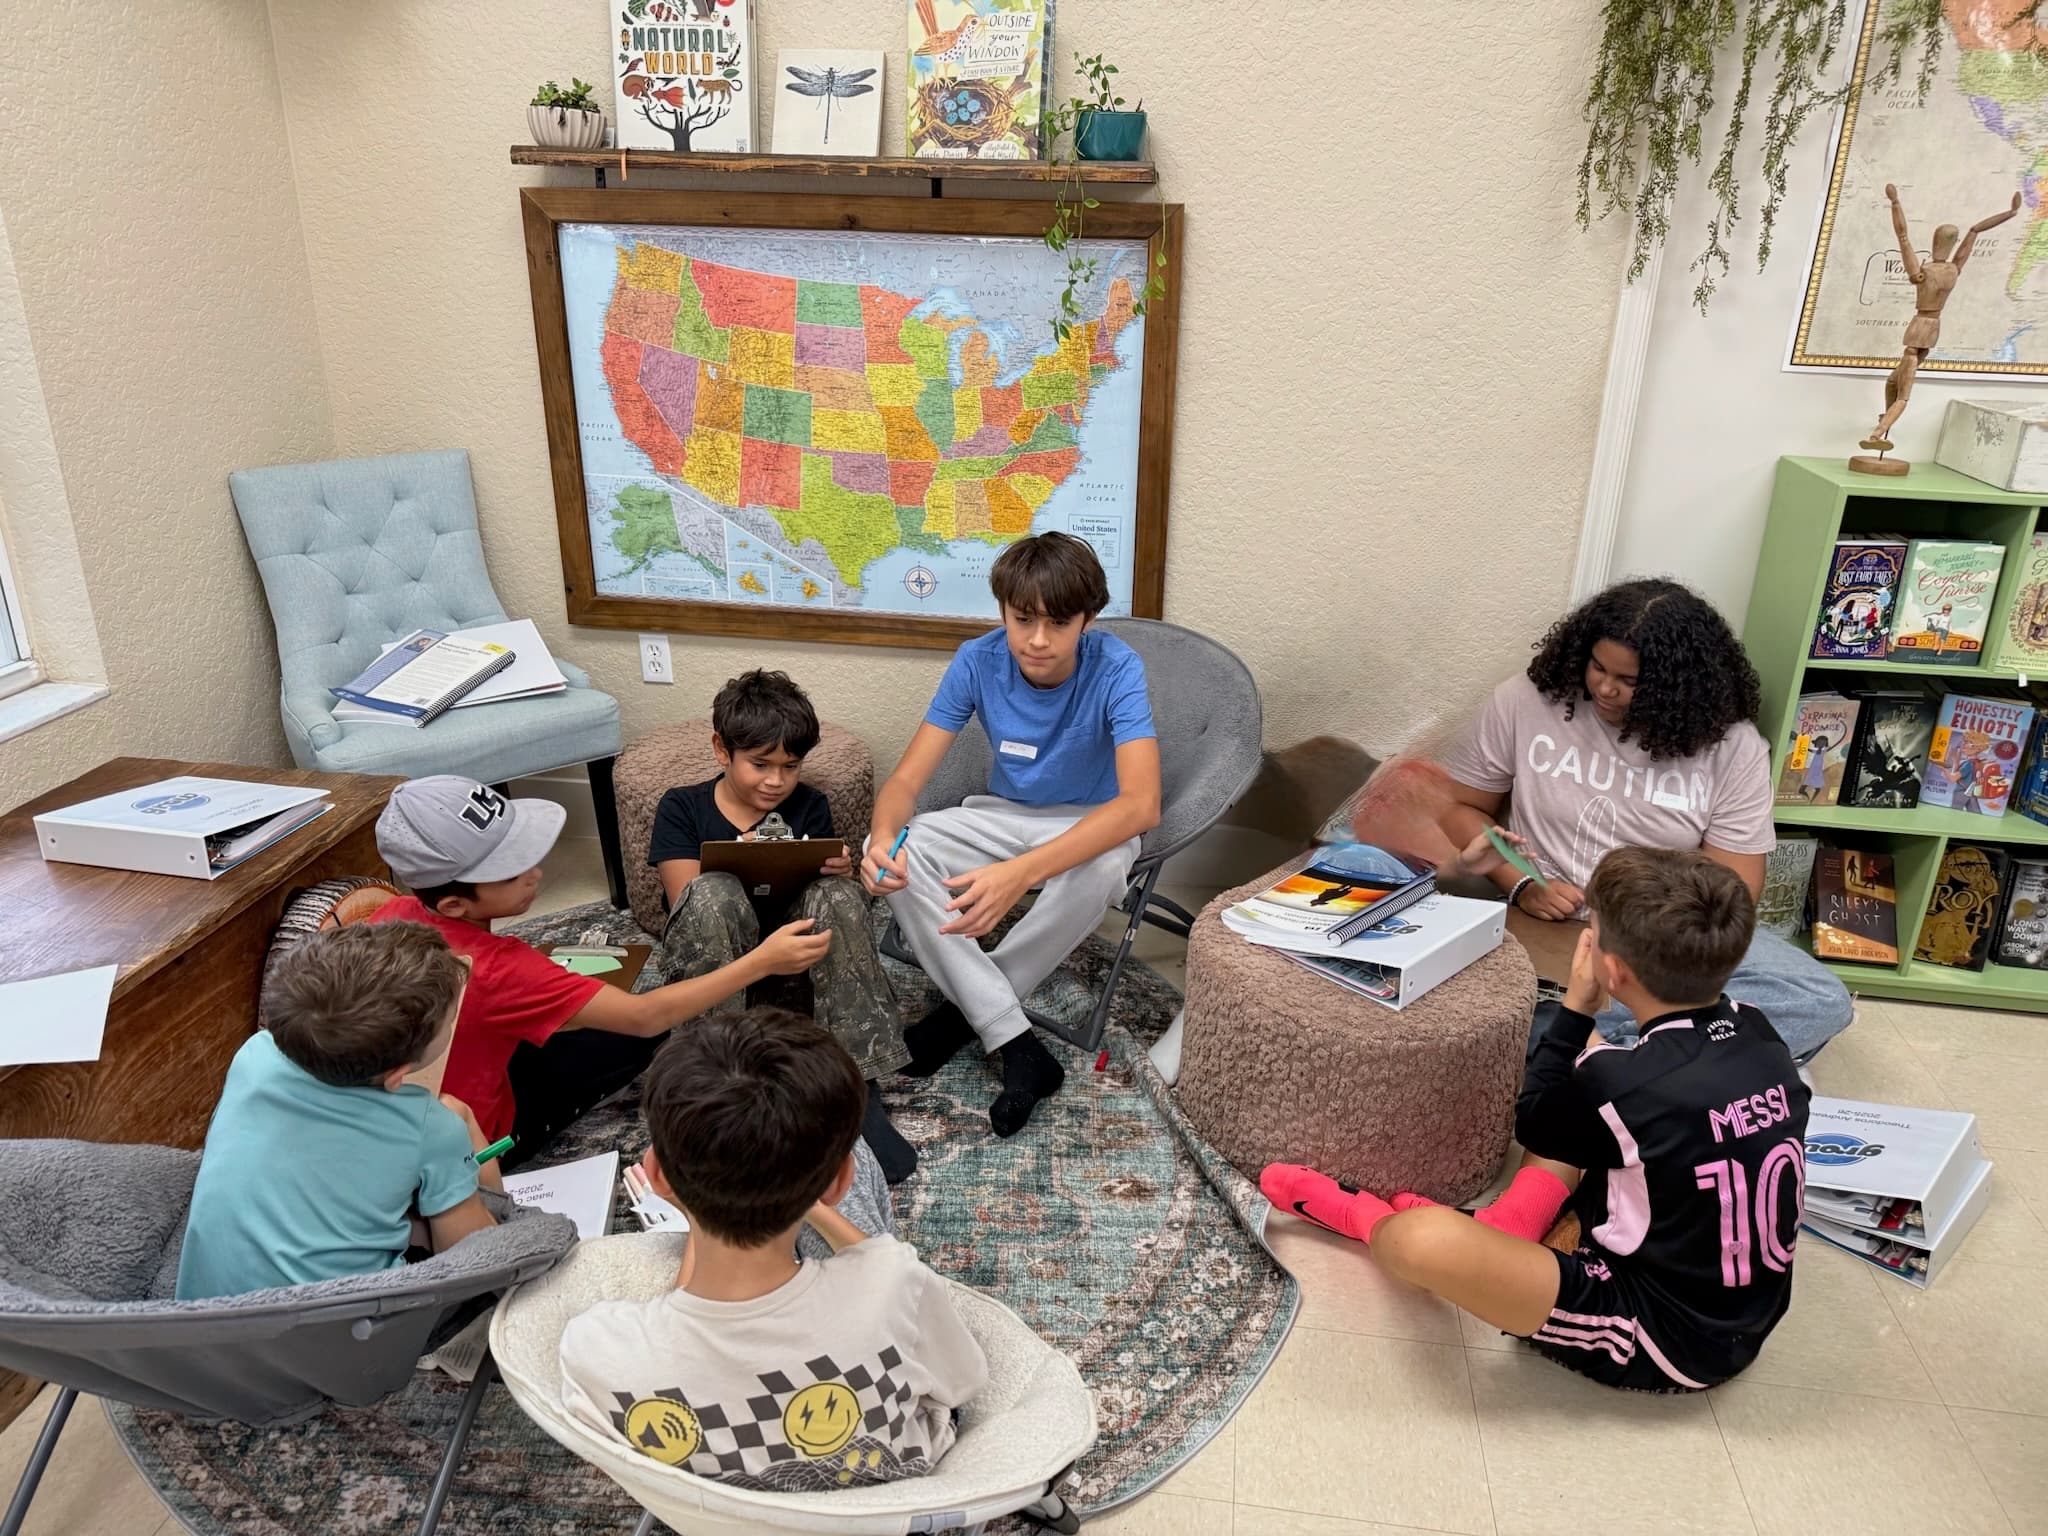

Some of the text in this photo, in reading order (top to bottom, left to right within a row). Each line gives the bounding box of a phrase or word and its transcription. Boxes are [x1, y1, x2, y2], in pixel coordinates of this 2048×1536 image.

[989, 14, 1032, 28] OUTSIDE
[632, 27, 728, 53] NATURAL
[988, 34, 1021, 46] your
[968, 45, 1021, 59] WINDOW
[644, 52, 714, 75] WORLD
[1856, 319, 1899, 327] SOUTHERN
[1096, 525, 1117, 533] States
[1918, 568, 1989, 591] Coyote
[1924, 582, 1988, 606] Sunrise
[1955, 699, 2023, 719] HONESTLY
[1801, 721, 1841, 735] PROMISE
[1951, 712, 2018, 739] ELLIOTT
[1528, 734, 1714, 812] CAUTION
[1830, 894, 1880, 910] RILEY'S
[1927, 884, 2000, 916] ROY
[2007, 924, 2027, 933] WAY
[2013, 919, 2039, 929] LONG
[2012, 931, 2041, 942] DOWN
[1706, 1019, 1735, 1034] FREEDOM
[1710, 1030, 1737, 1041] DREAM
[1709, 1084, 1790, 1143] MESSI
[1804, 1143, 1885, 1157] grou
[1694, 1137, 1806, 1287] 10
